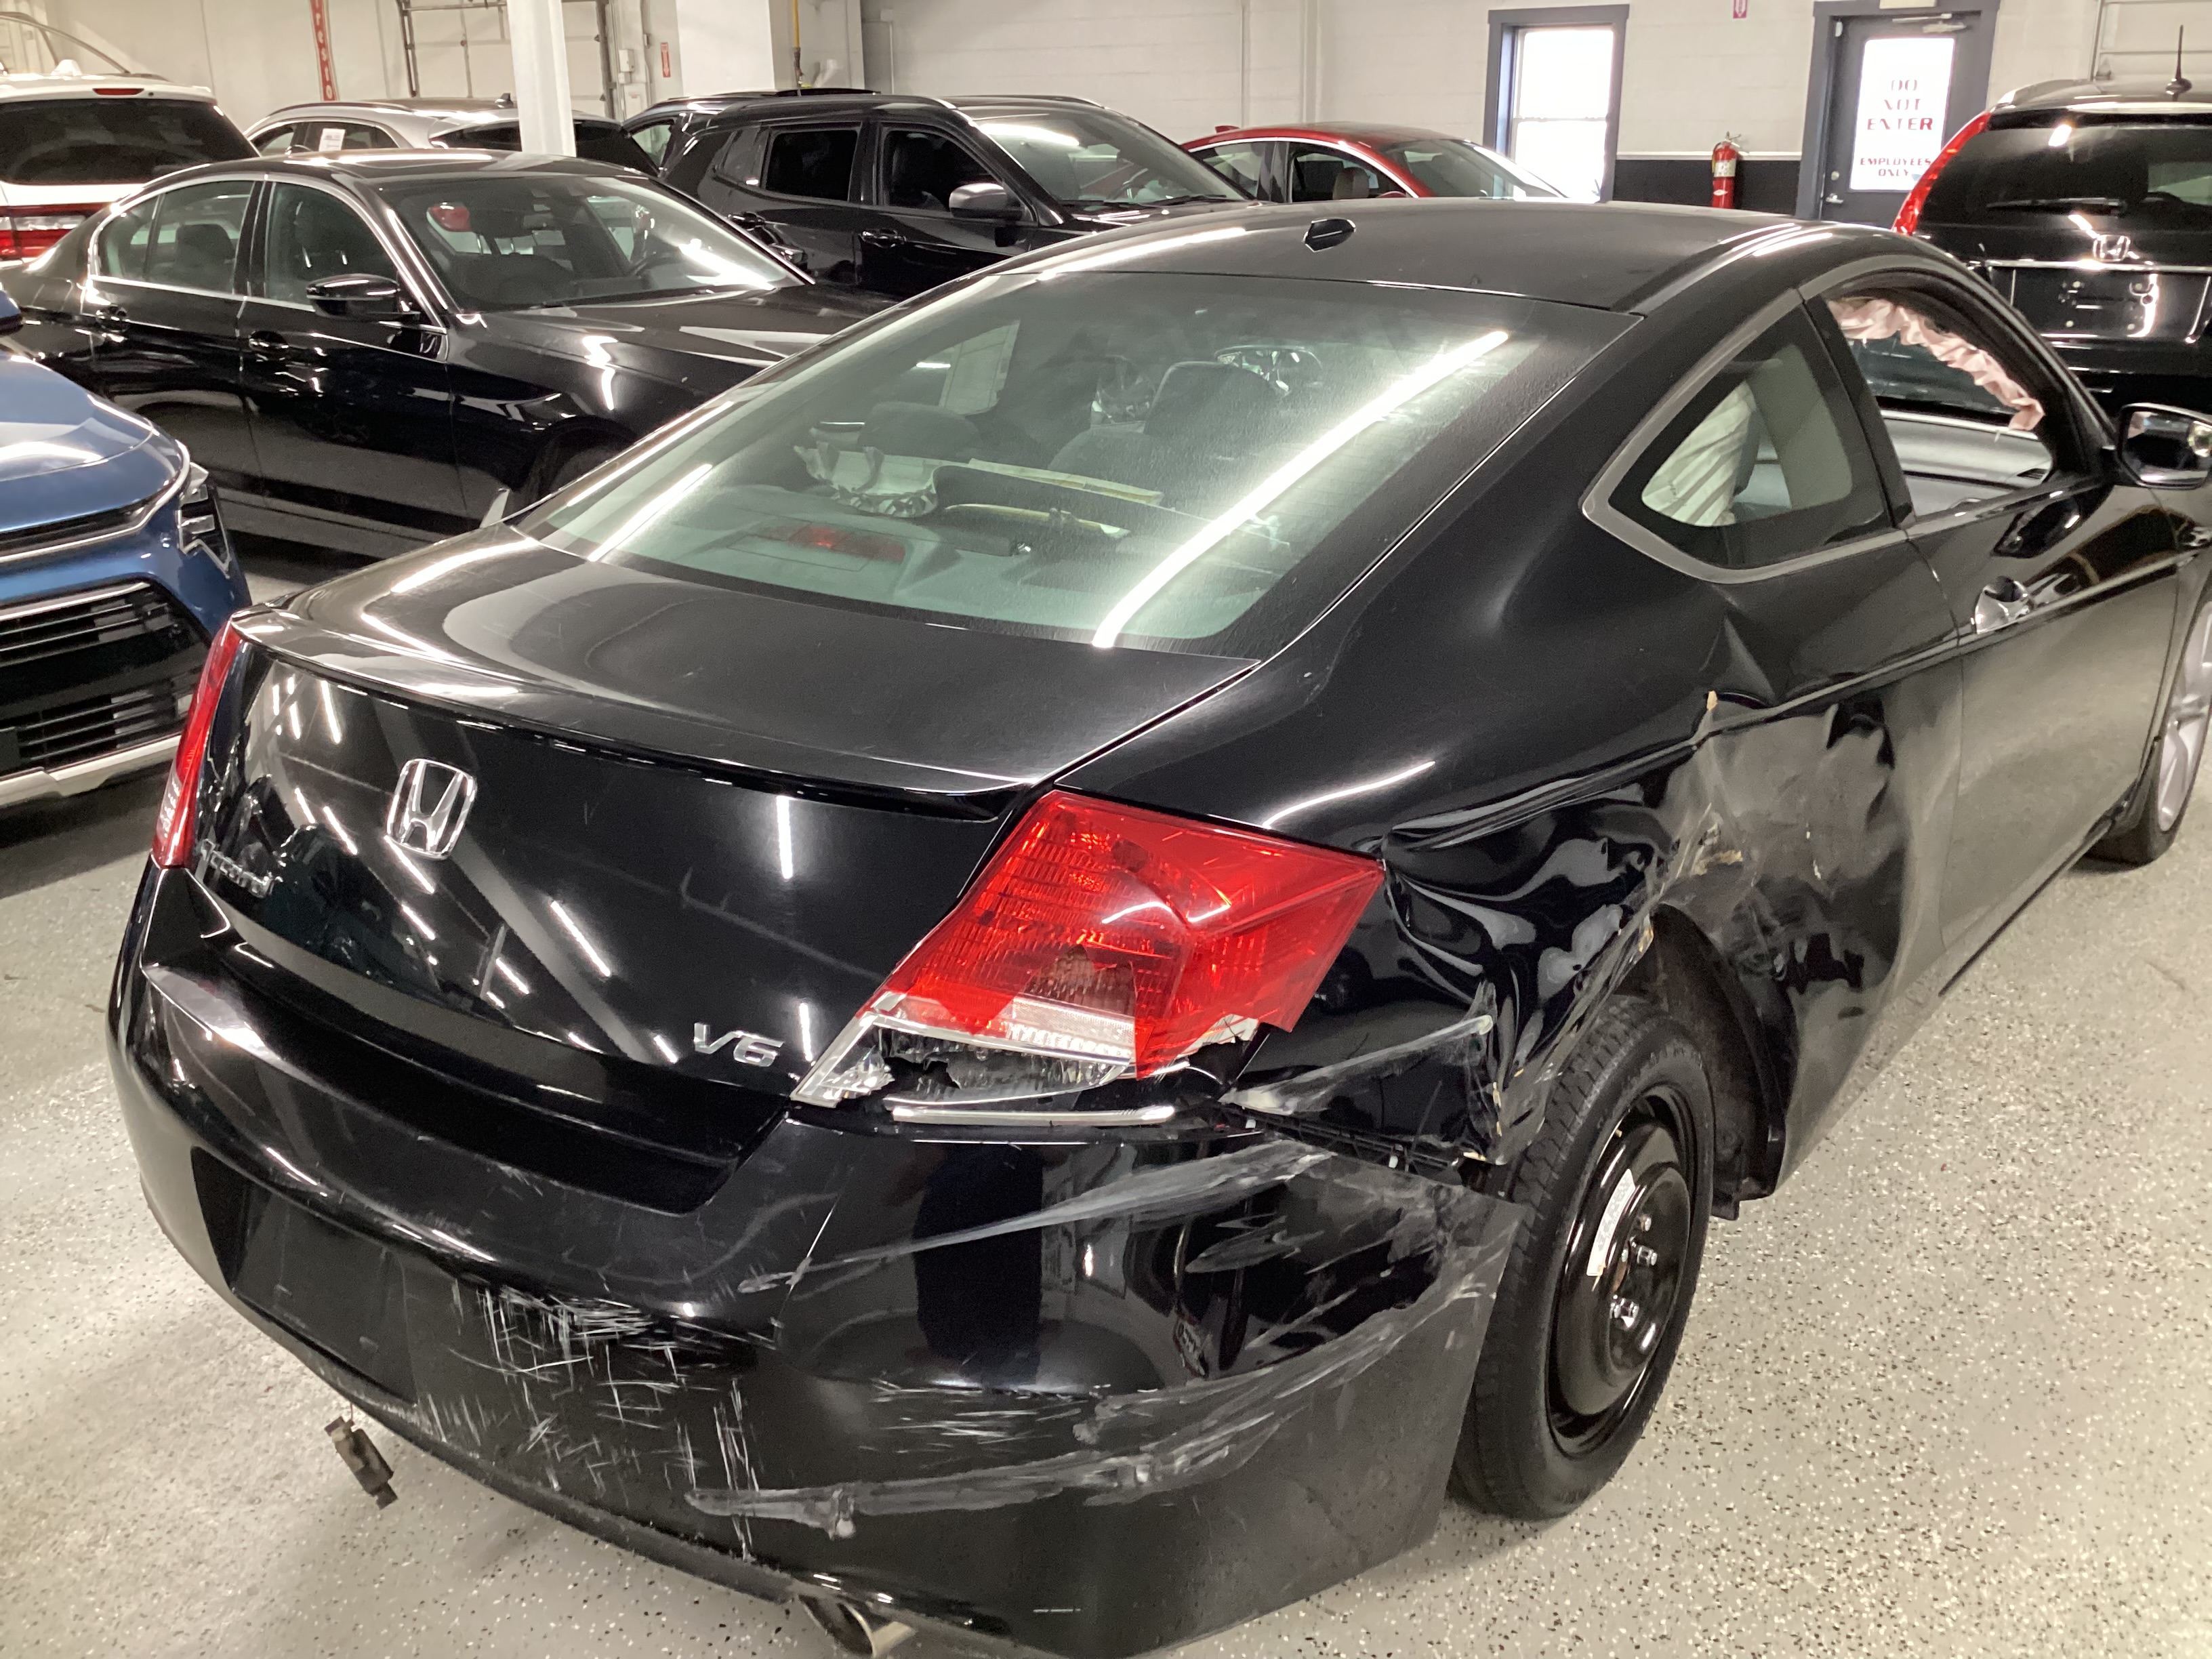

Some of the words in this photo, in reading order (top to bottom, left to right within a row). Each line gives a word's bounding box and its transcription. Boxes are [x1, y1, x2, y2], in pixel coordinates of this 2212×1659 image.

[1891, 79, 1918, 91] DO
[1883, 98, 1921, 110] NOT
[1866, 117, 1933, 130] ENTER
[1859, 157, 1931, 166] EMPLOYEES
[1877, 169, 1909, 177] ONLY
[693, 1022, 785, 1067] V6
